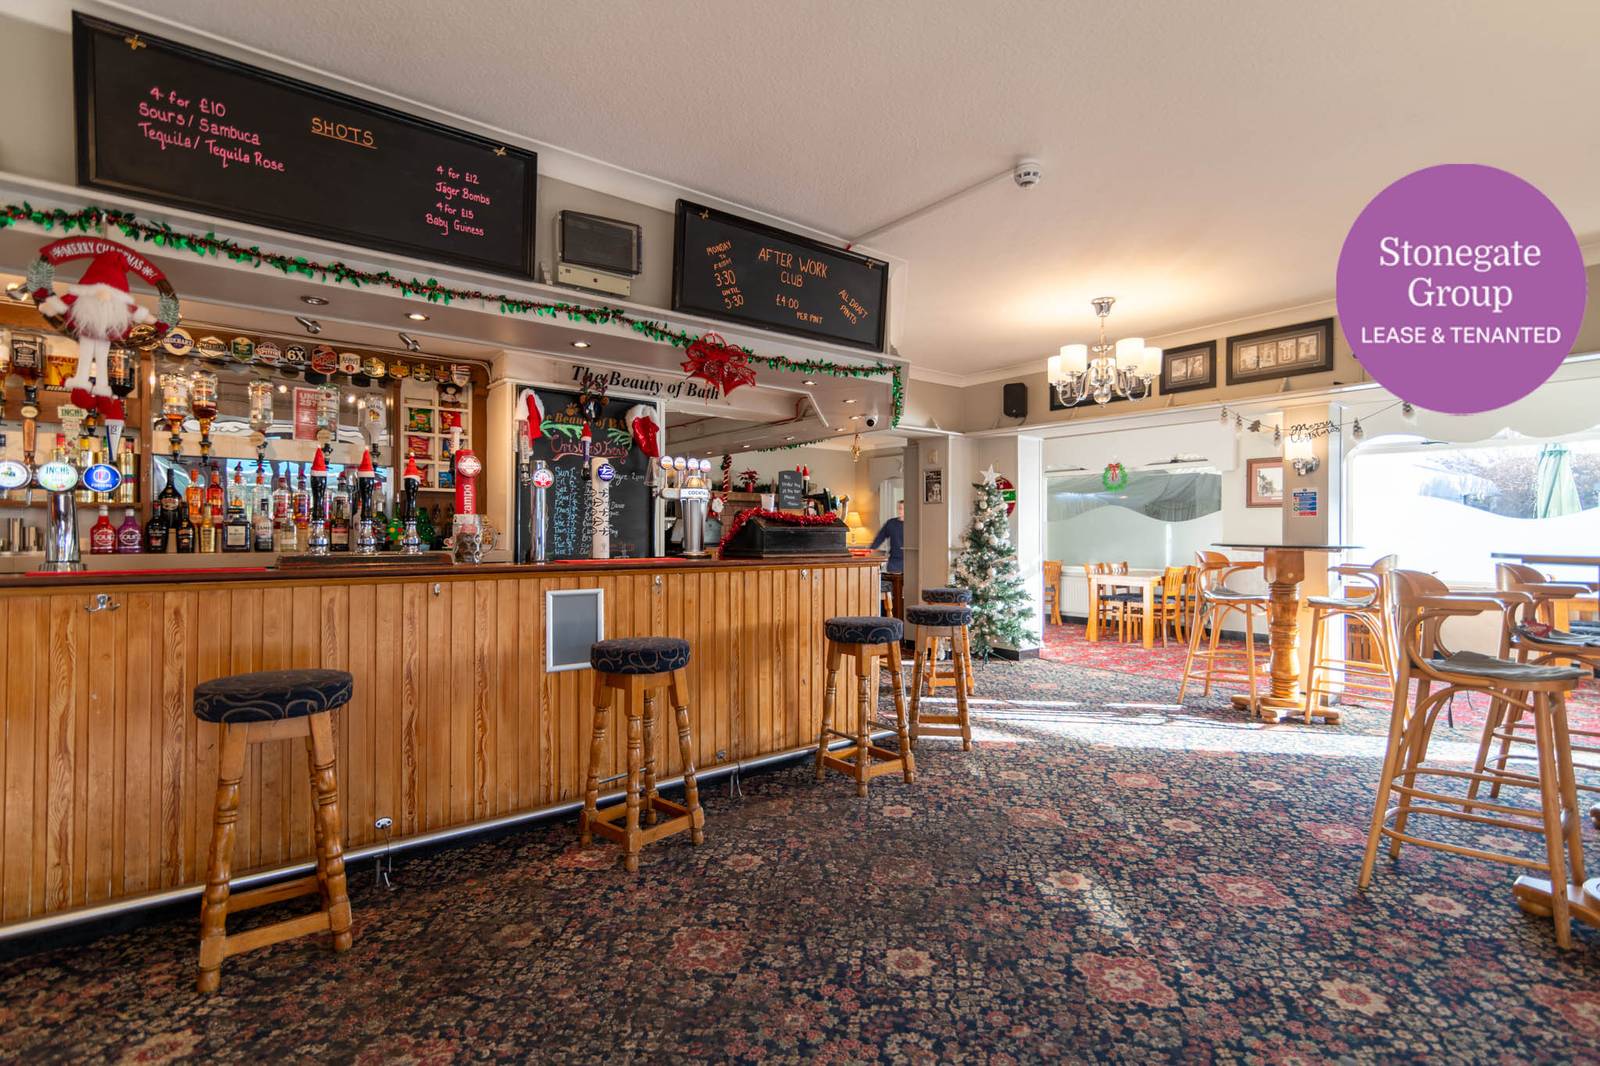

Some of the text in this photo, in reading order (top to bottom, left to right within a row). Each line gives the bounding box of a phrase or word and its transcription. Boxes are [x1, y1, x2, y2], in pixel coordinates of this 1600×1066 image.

[150, 87, 226, 117] 4 for £10
[199, 118, 262, 146] Sambuca
[311, 116, 375, 147] SHOTS
[205, 139, 251, 168] Tequila
[254, 151, 286, 172] Rose
[436, 165, 480, 185] 4 for £12
[462, 187, 491, 205] Bombs
[436, 201, 474, 219] 4 for £15
[425, 213, 448, 236] Baby
[61, 241, 95, 257] MERRY
[706, 240, 732, 256] MONDAY
[758, 247, 828, 279] AFTER WORK
[780, 271, 804, 288] CLUB
[796, 311, 824, 325] PER PINT
[287, 349, 305, 361] 6X
[572, 365, 720, 400] The Beauty of Bath
